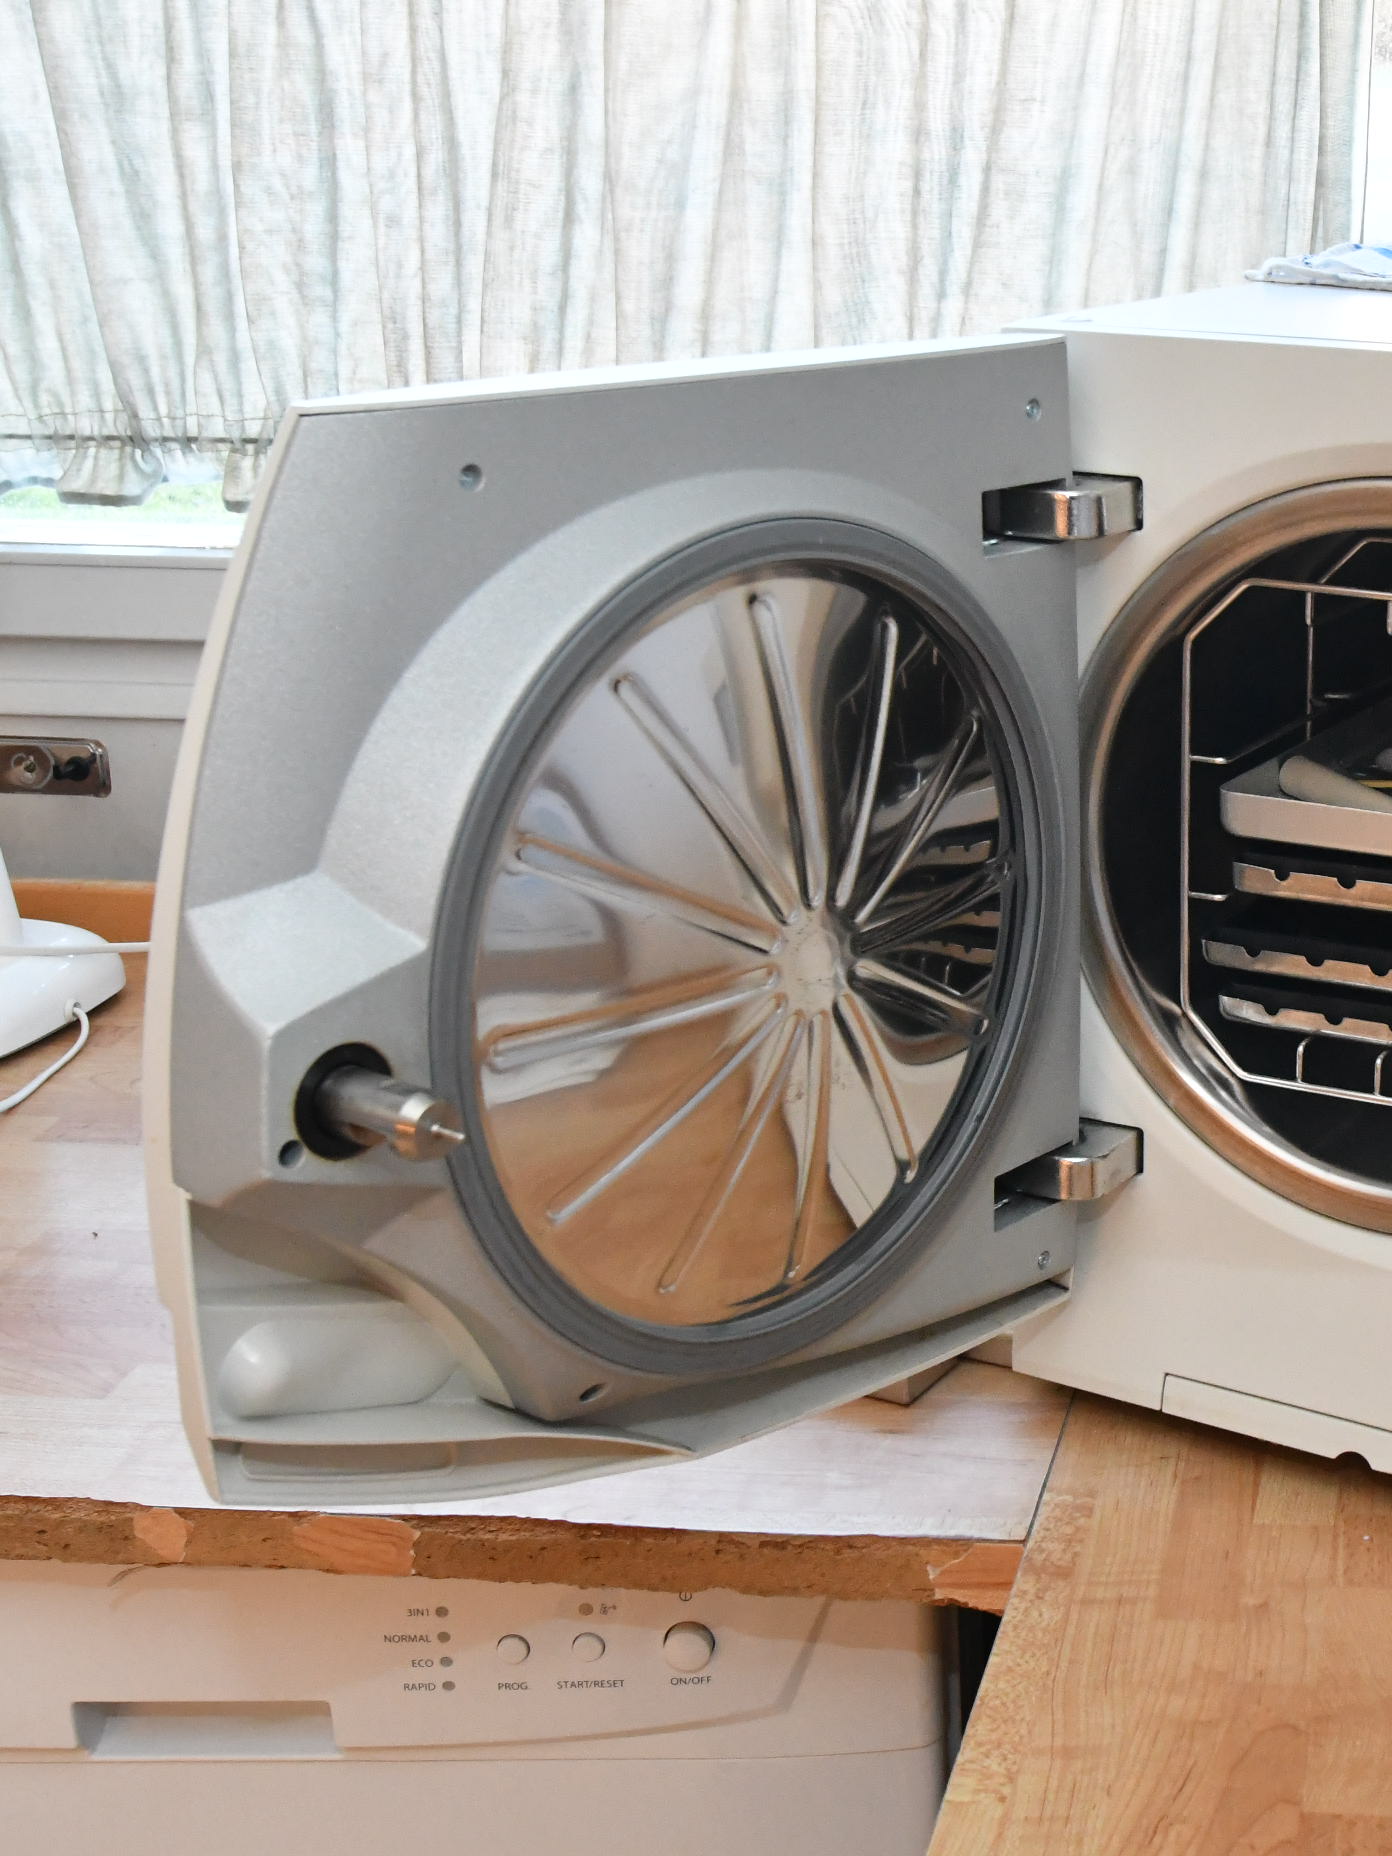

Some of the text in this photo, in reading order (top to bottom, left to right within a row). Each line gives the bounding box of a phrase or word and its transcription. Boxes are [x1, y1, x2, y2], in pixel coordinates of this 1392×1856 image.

[407, 1607, 431, 1618] 3IN1
[383, 1634, 432, 1643] NORMAL
[411, 1659, 434, 1668] ECO
[556, 1679, 625, 1690] START/RESET
[669, 1675, 713, 1686] ON/OFF
[403, 1682, 436, 1692] RAPID
